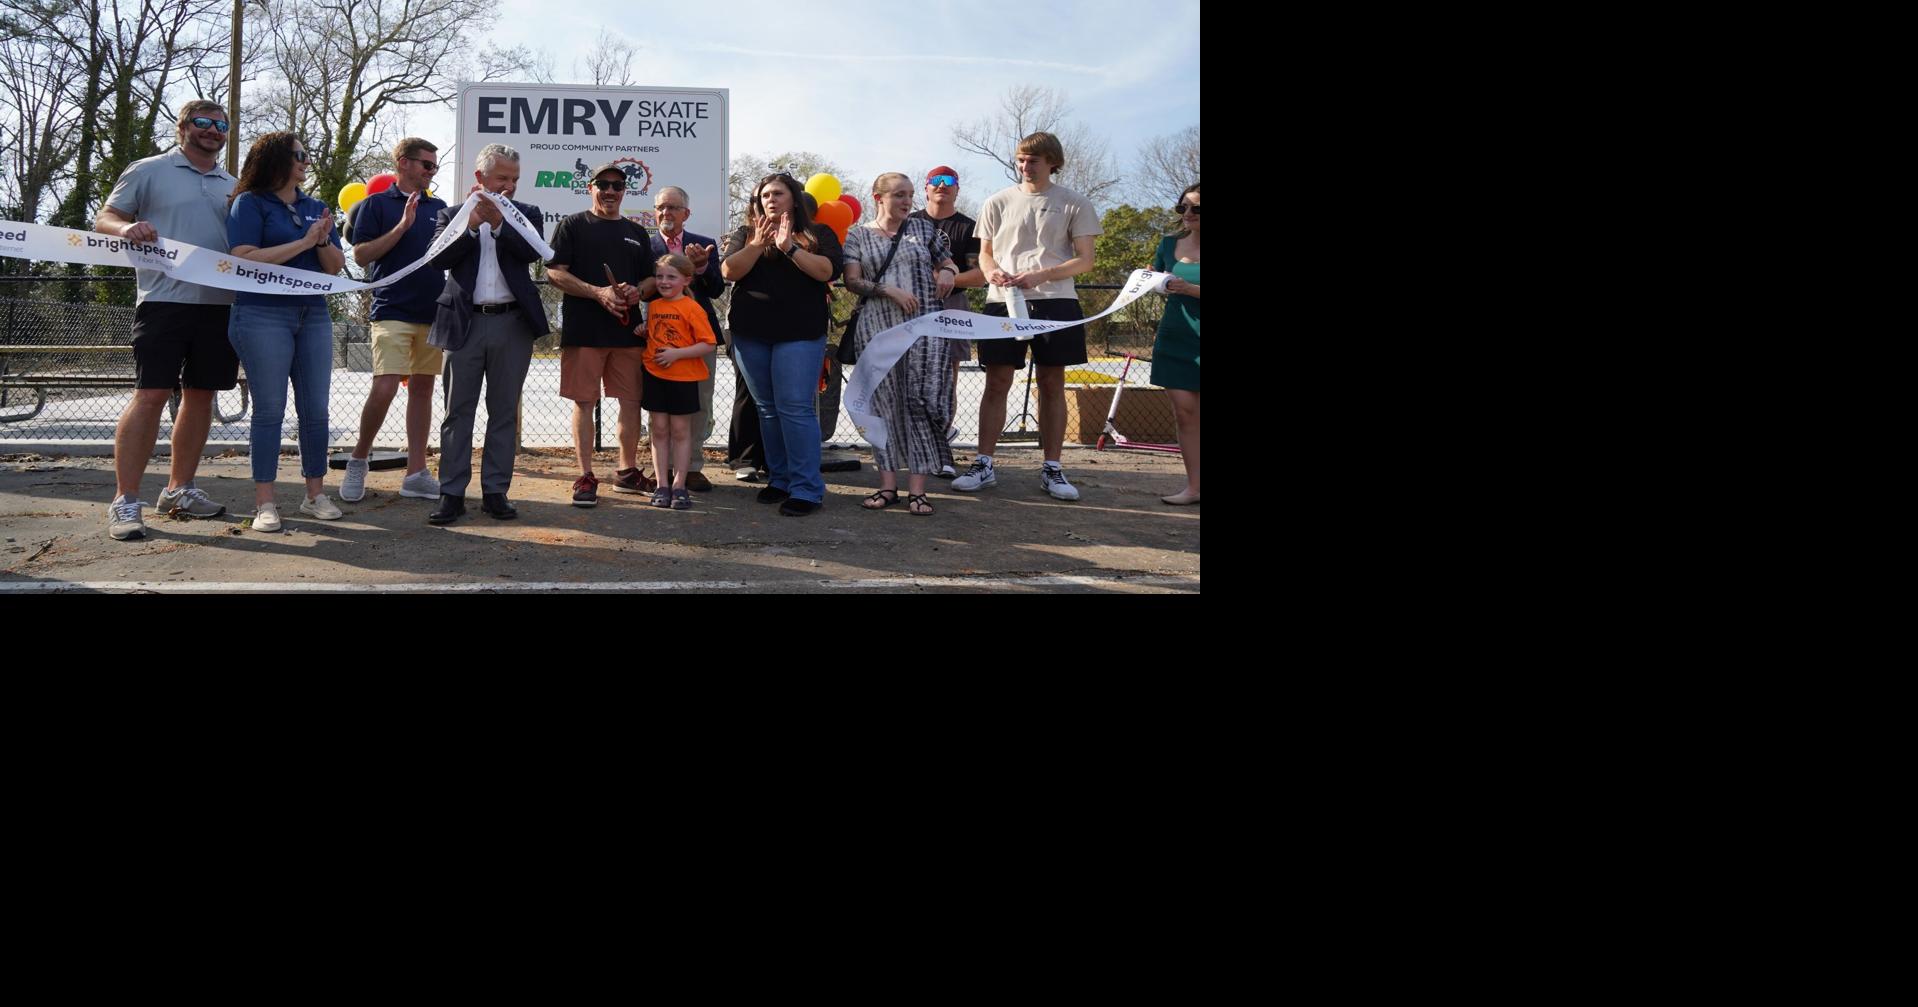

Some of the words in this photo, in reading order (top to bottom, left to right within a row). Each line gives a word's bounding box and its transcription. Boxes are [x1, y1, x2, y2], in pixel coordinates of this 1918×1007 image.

[477, 96, 634, 137] EMRY
[638, 100, 709, 119] SKATE
[638, 120, 697, 138] PARK
[530, 143, 561, 151] PROUD
[562, 144, 614, 153] COMMUNITY
[615, 145, 660, 153] PARTNERS
[86, 236, 179, 261] brightspeed
[236, 265, 333, 292] brightspeed
[934, 314, 973, 328] speed
